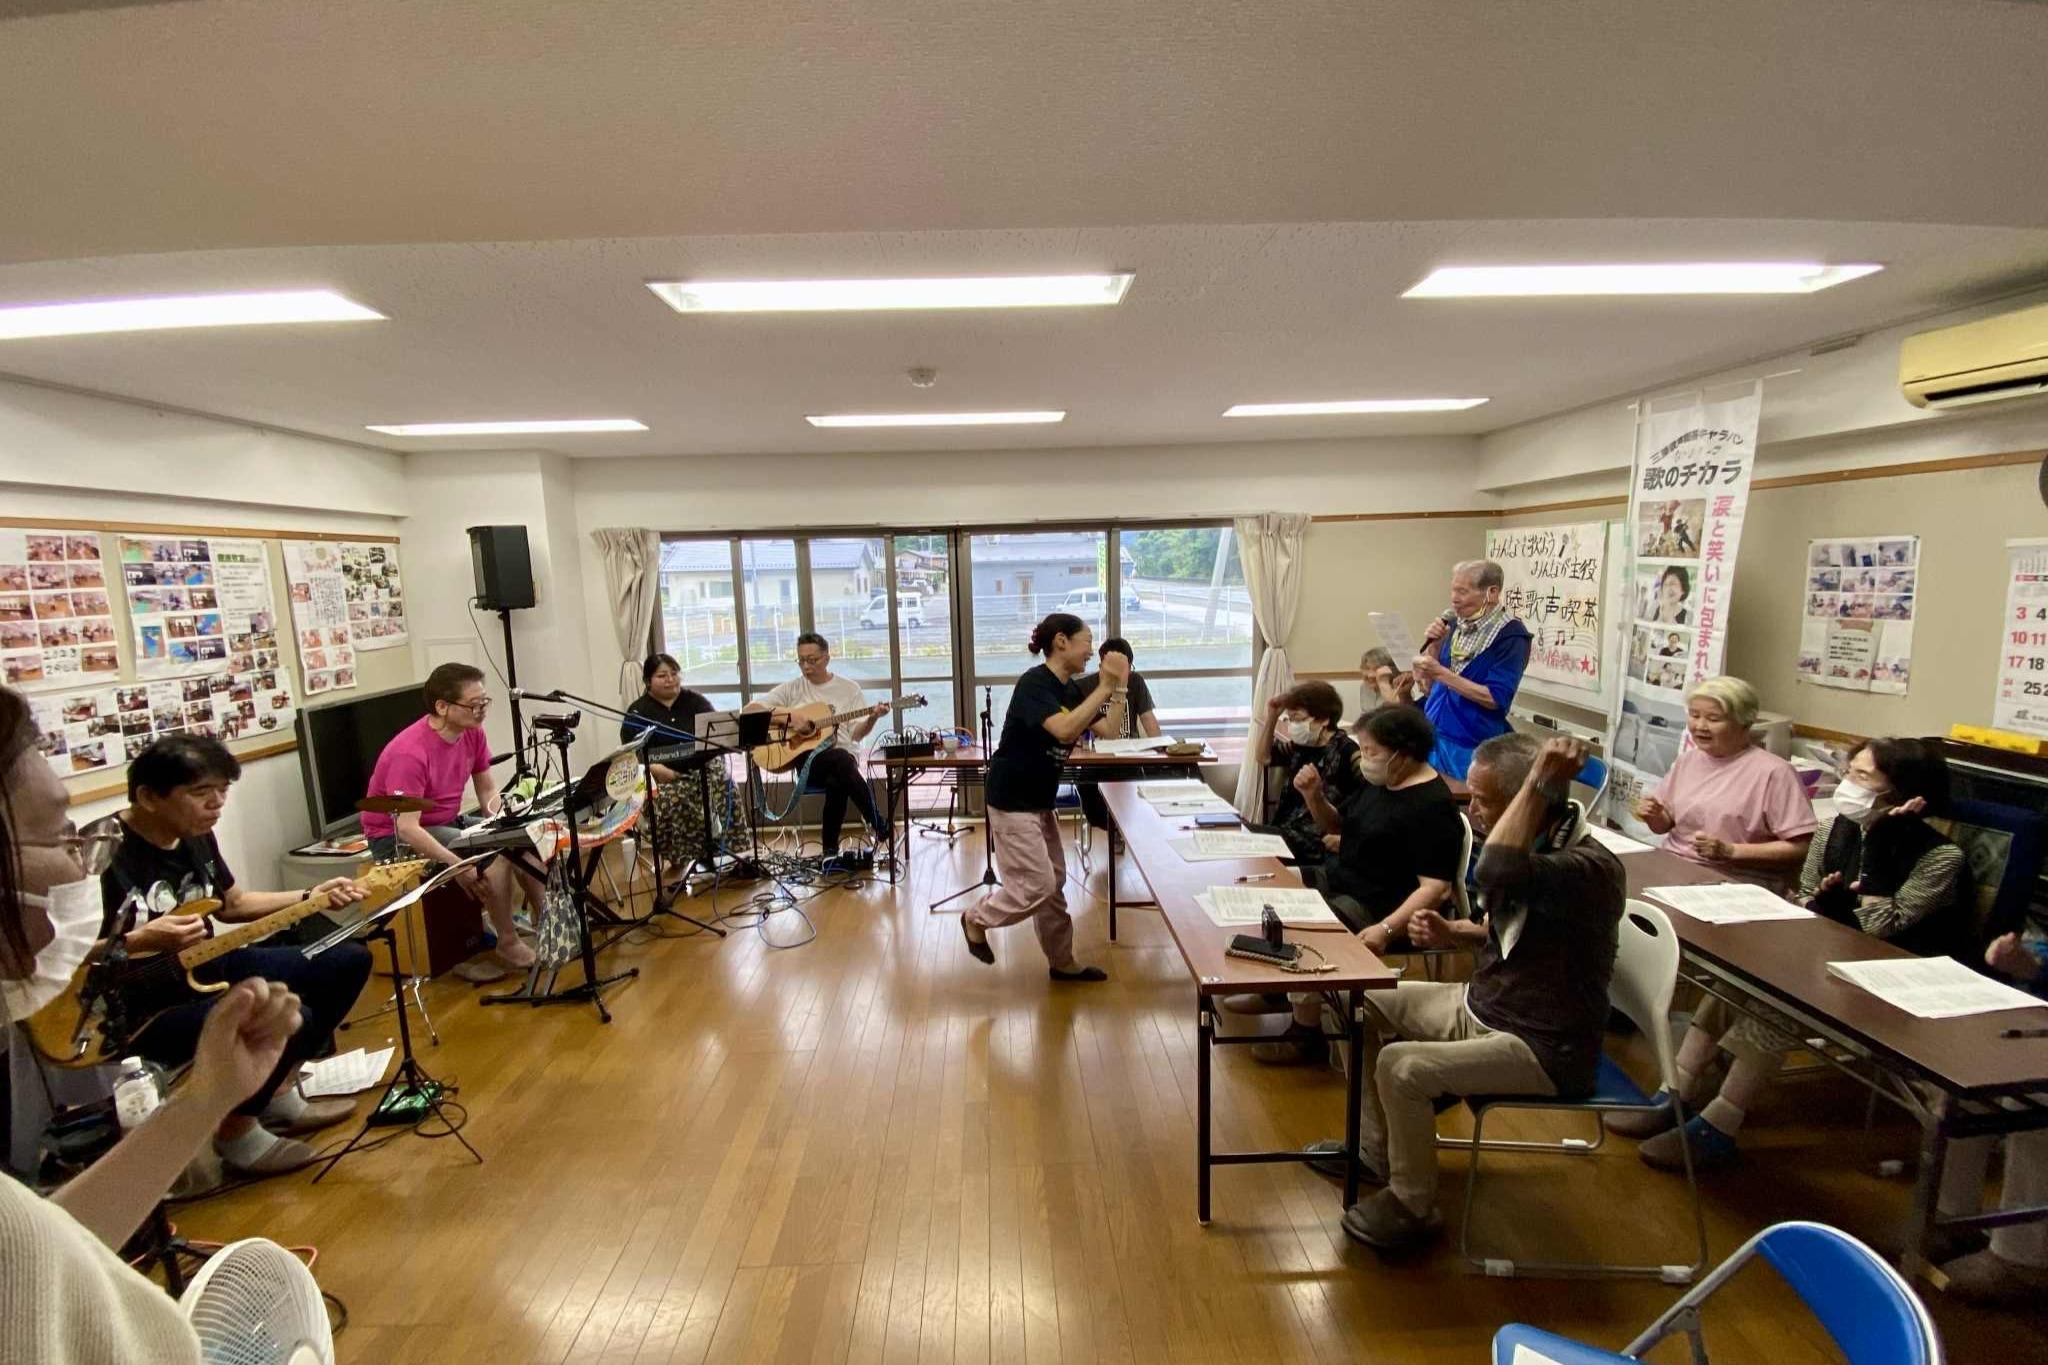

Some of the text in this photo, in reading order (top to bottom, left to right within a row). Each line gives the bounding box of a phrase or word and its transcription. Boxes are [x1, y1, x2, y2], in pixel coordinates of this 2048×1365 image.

[1643, 459, 1741, 490] 歌のチカラ
[1530, 555, 1597, 582] みんなが主役
[2016, 607, 2047, 620] 3 4
[2011, 631, 2047, 645] 10 11
[2008, 656, 2044, 670] 17 18
[2023, 681, 2042, 695] 25
